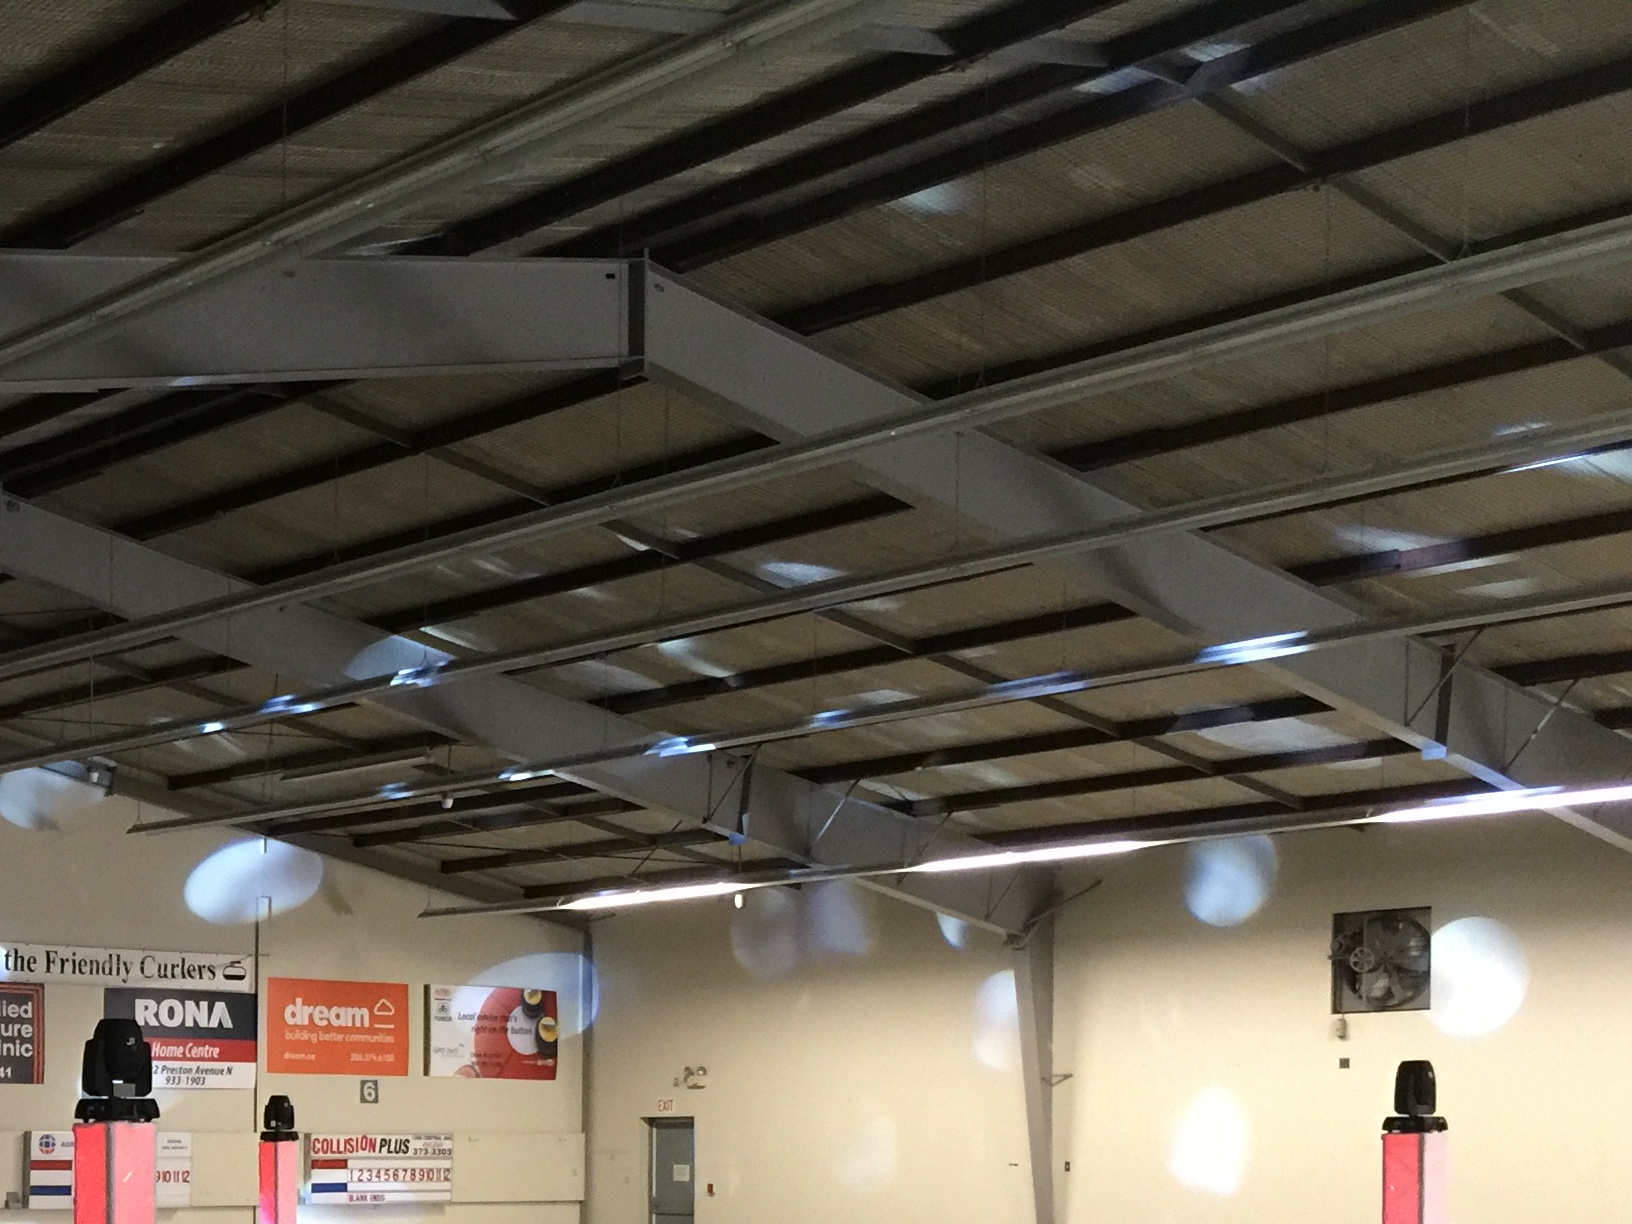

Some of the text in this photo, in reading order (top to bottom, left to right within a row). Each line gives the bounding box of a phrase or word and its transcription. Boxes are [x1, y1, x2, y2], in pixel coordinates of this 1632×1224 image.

[4, 949, 38, 973] the
[44, 950, 134, 984] Friendly
[140, 954, 216, 981] Curlers
[134, 998, 233, 1030] RONA
[284, 998, 369, 1027] dream
[457, 1012, 476, 1021] Local
[285, 1030, 317, 1044] building
[344, 1033, 394, 1043] communities
[151, 1042, 220, 1059] Home Centre
[161, 1065, 193, 1075] Preston
[194, 1066, 225, 1076] Avenue
[226, 1066, 233, 1075] N
[364, 1082, 376, 1101] 6
[658, 1100, 674, 1111] EXIT
[312, 1134, 377, 1155] COLLISION
[378, 1138, 411, 1154] PLUS
[162, 1170, 172, 1184] 10
[173, 1170, 180, 1184] 11
[182, 1170, 190, 1184] 12
[350, 1169, 451, 1181] 1 2 3 4 5 6 7 8 9 10 11 12
[348, 1194, 386, 1202] BLANK ENDS
